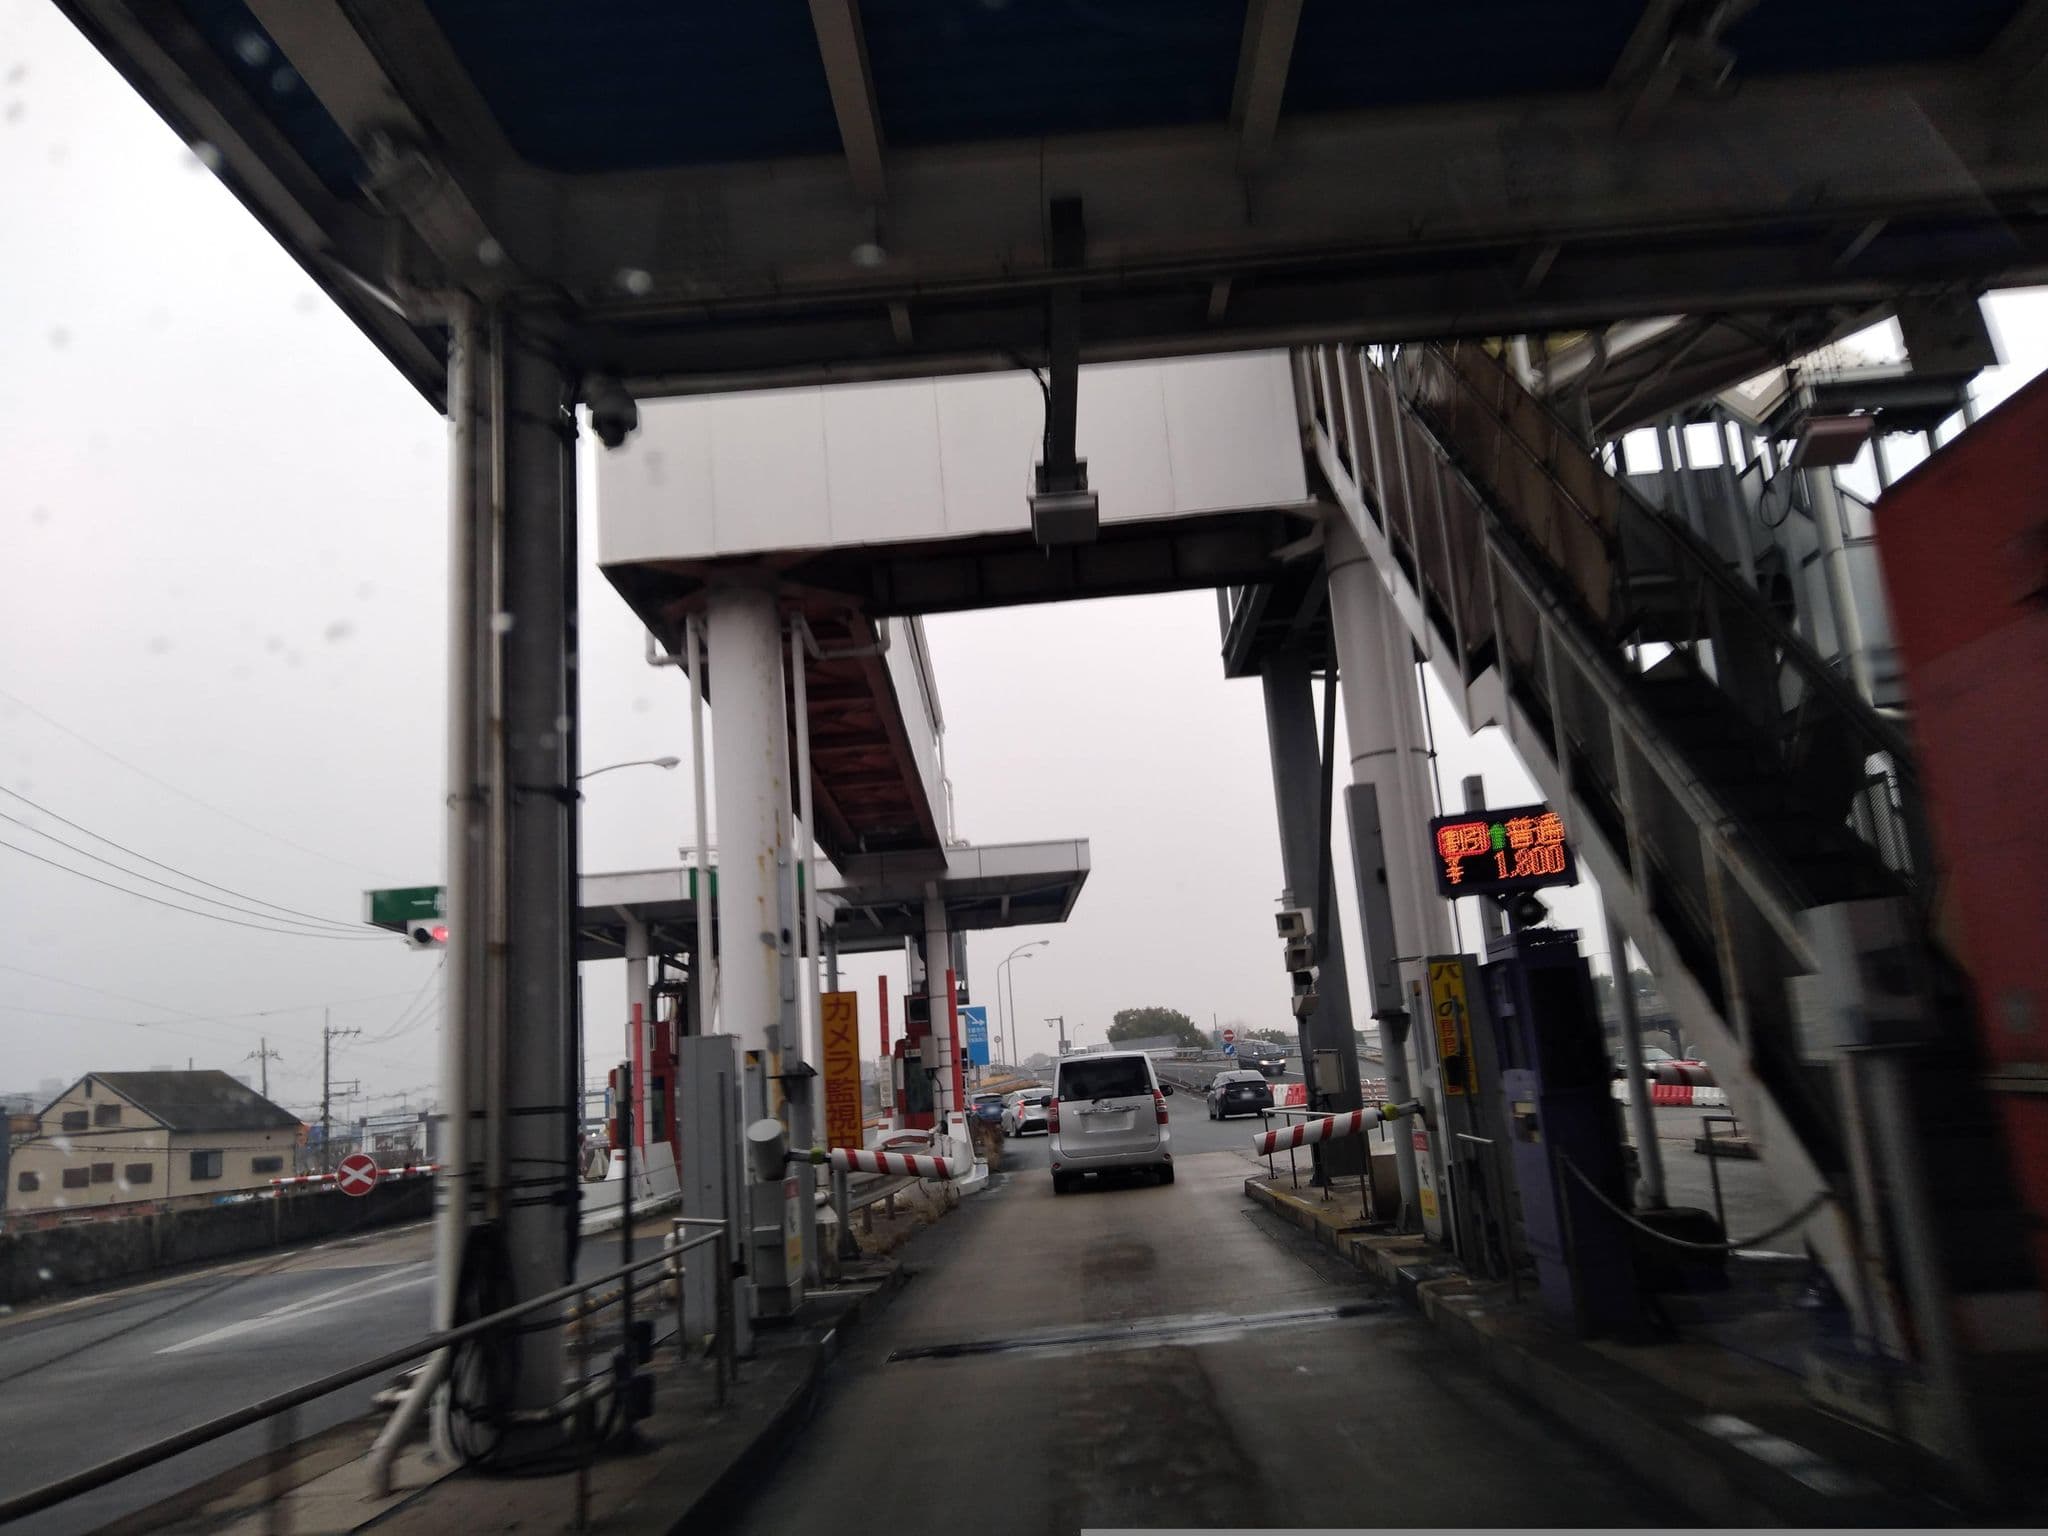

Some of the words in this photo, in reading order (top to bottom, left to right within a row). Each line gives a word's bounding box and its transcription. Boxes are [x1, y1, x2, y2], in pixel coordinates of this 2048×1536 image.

[1506, 812, 1565, 849] 普通
[824, 996, 857, 1149] カメラ監視中
